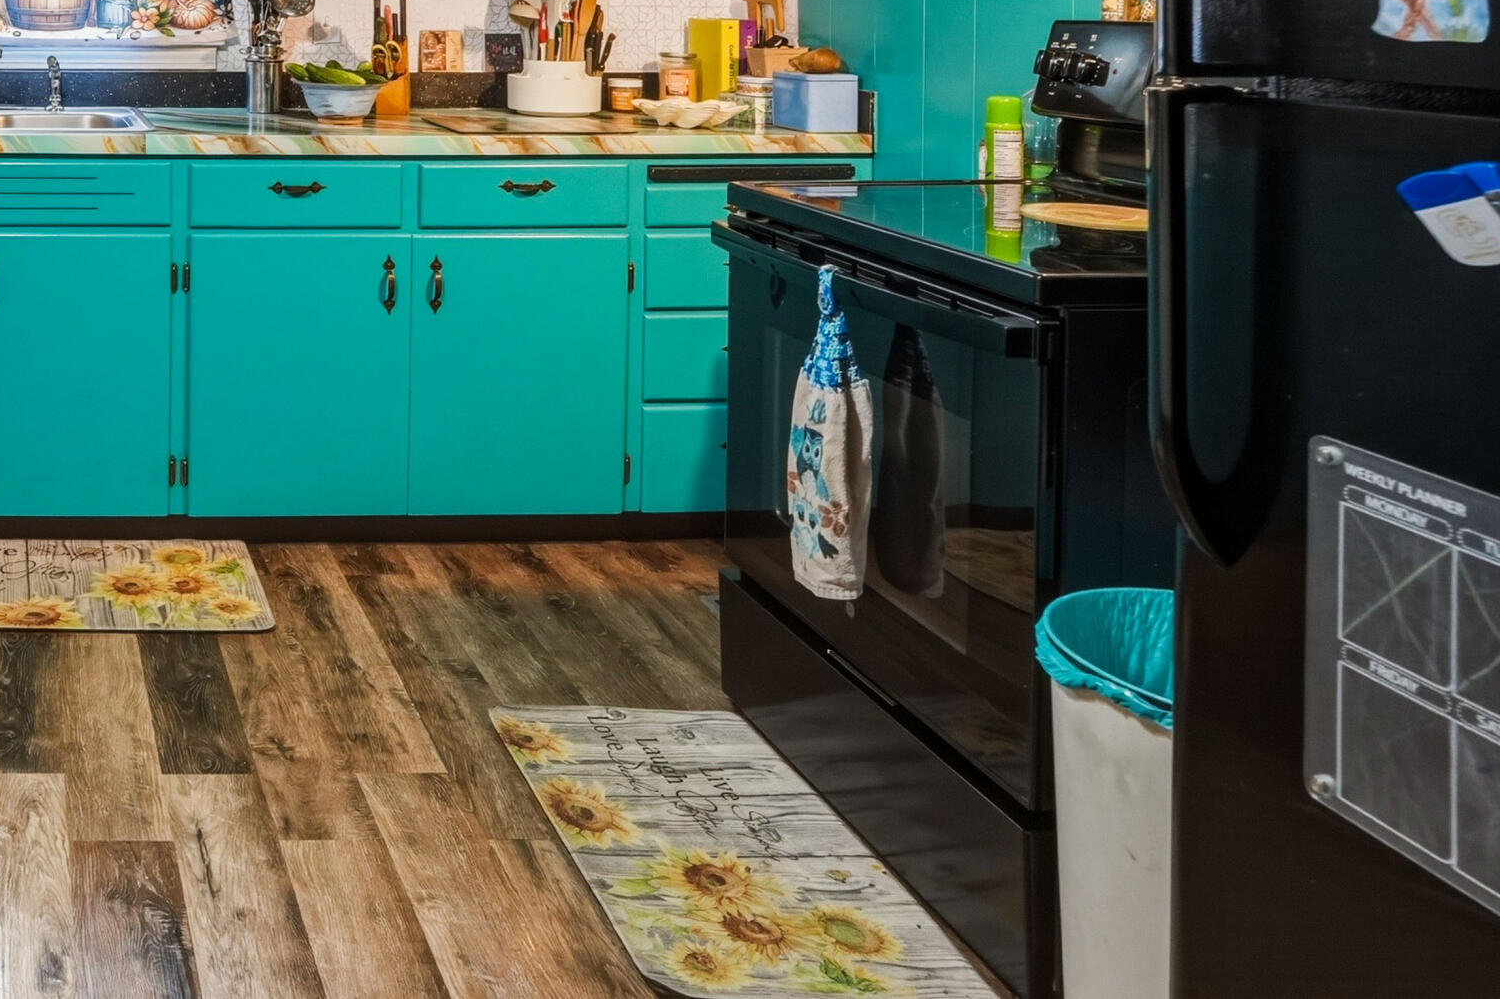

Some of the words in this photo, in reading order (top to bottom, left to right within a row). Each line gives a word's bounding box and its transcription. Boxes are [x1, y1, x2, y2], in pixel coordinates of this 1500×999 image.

[1343, 461, 1397, 491] WEEKLY
[1397, 482, 1467, 518] PLANNER
[1364, 494, 1429, 527] MONDAY
[1368, 660, 1421, 694] FRIDAY
[587, 715, 625, 752] Love
[634, 737, 688, 786] Laugh
[699, 767, 741, 801] Live
